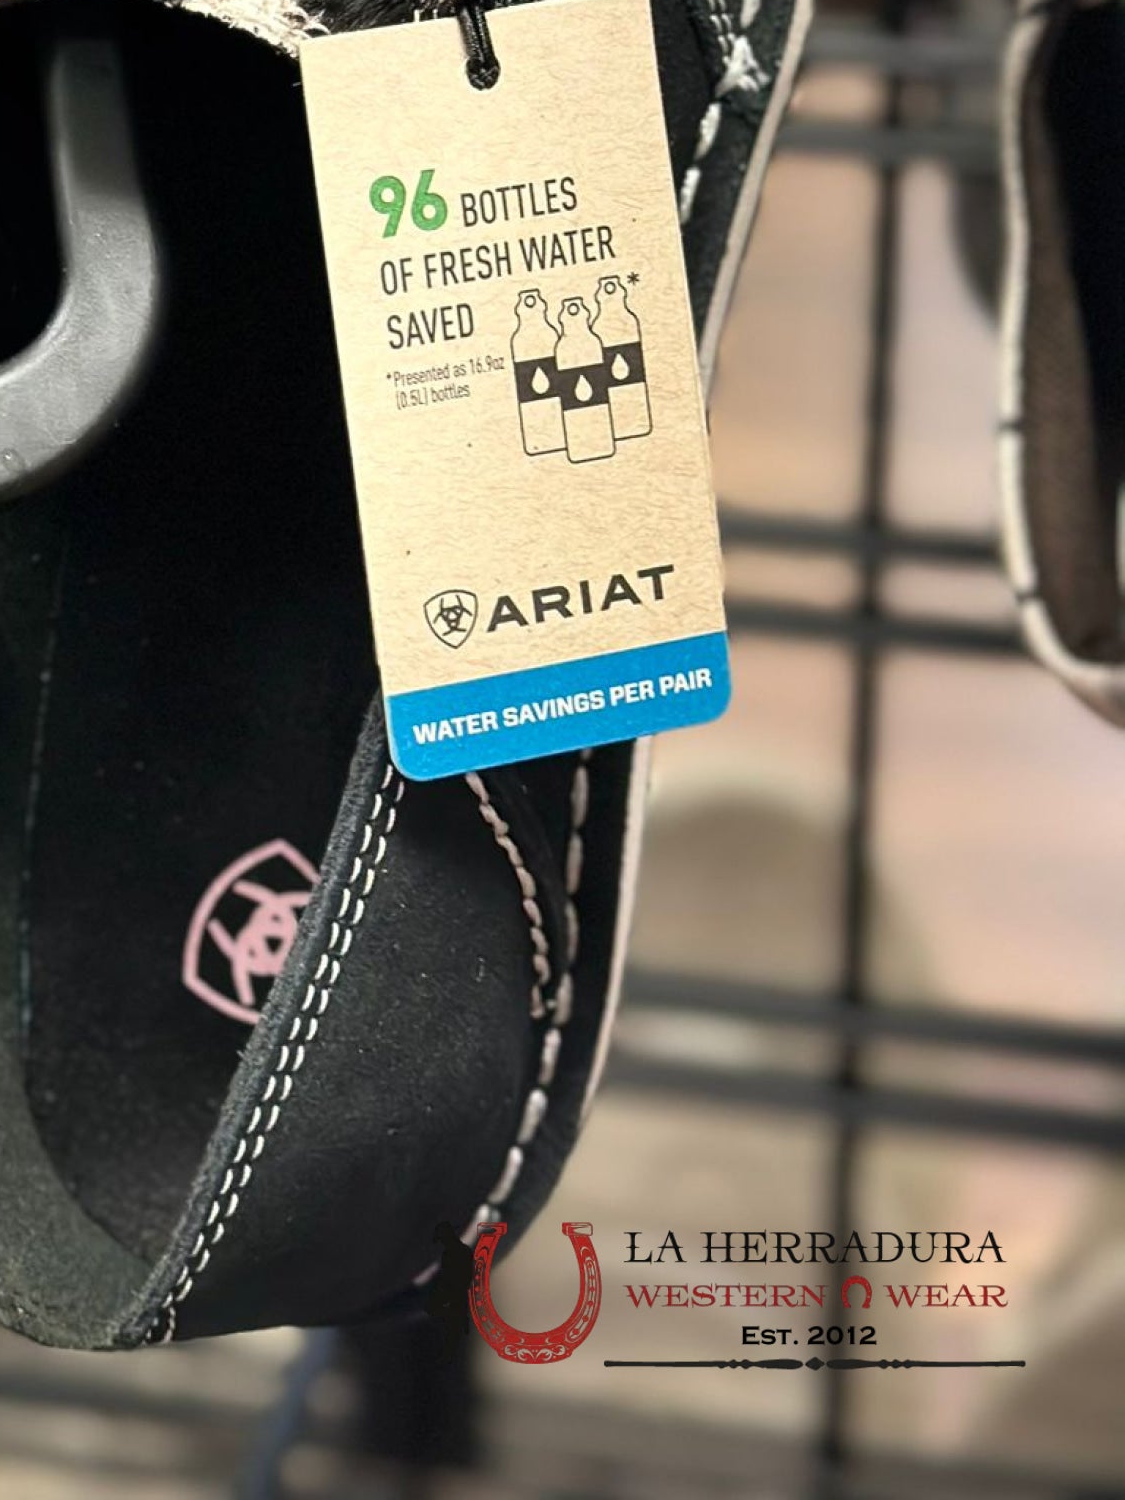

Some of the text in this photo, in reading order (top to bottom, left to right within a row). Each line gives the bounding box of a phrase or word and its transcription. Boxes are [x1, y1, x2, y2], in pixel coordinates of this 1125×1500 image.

[369, 169, 577, 238] 96 BOTTLES
[380, 225, 616, 295] OF FRESH WATER
[387, 303, 474, 349] SAVED
[431, 383, 470, 402] bottles
[453, 363, 467, 377] as
[487, 564, 675, 633] ARIAT
[413, 668, 713, 744] WATER SAVINGS PER PAIR
